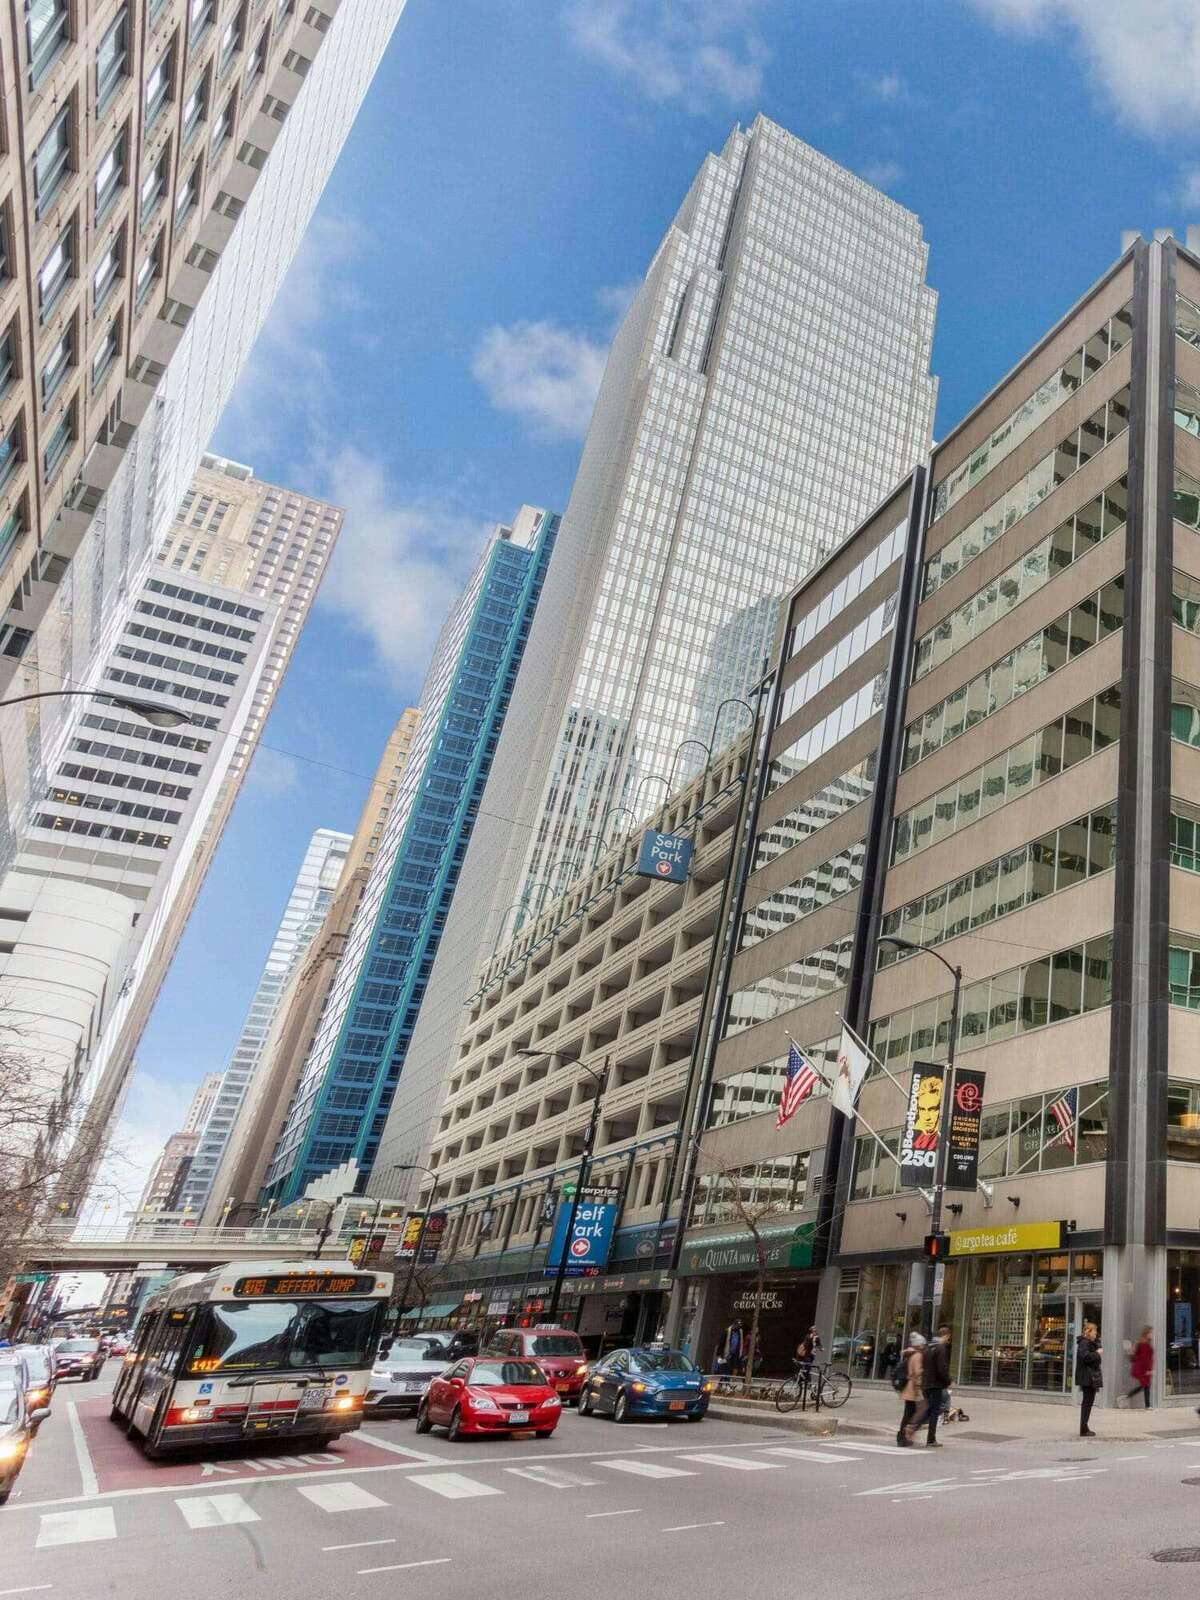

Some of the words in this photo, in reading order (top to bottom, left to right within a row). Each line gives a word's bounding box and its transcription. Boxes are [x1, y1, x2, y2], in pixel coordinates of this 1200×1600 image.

[655, 834, 683, 850] Self
[651, 846, 682, 863] Park
[902, 1073, 921, 1149] Beethoven
[902, 1149, 936, 1168] 250
[573, 1222, 604, 1237] ark
[961, 1236, 980, 1252] argo
[981, 1233, 995, 1247] tea
[997, 1227, 1018, 1246] café
[706, 1249, 739, 1271] QUINTA
[740, 1253, 750, 1264] INN
[274, 1279, 325, 1294] JEFFERY
[326, 1278, 356, 1292] JUMP
[733, 1300, 784, 1309] CREAIONS
[201, 1453, 345, 1477] ONLY
